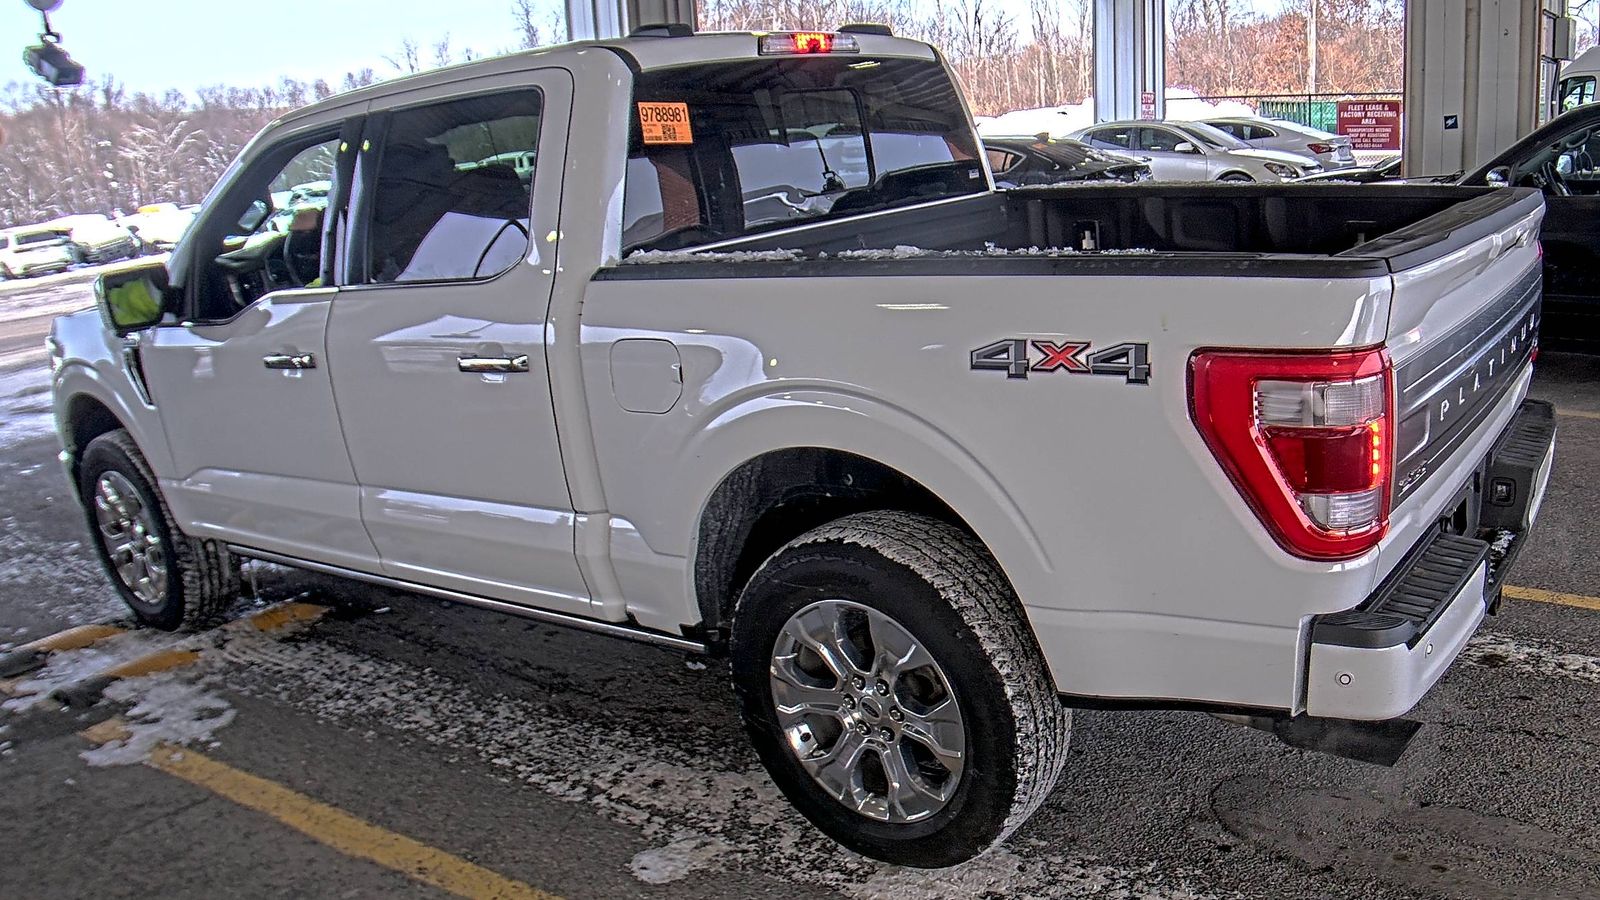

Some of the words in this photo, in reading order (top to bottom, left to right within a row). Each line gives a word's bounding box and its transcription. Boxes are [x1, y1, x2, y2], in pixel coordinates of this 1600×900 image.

[641, 106, 687, 122] 9788981
[970, 339, 1152, 386] 4X4
[1440, 313, 1535, 421] PLATINUM
